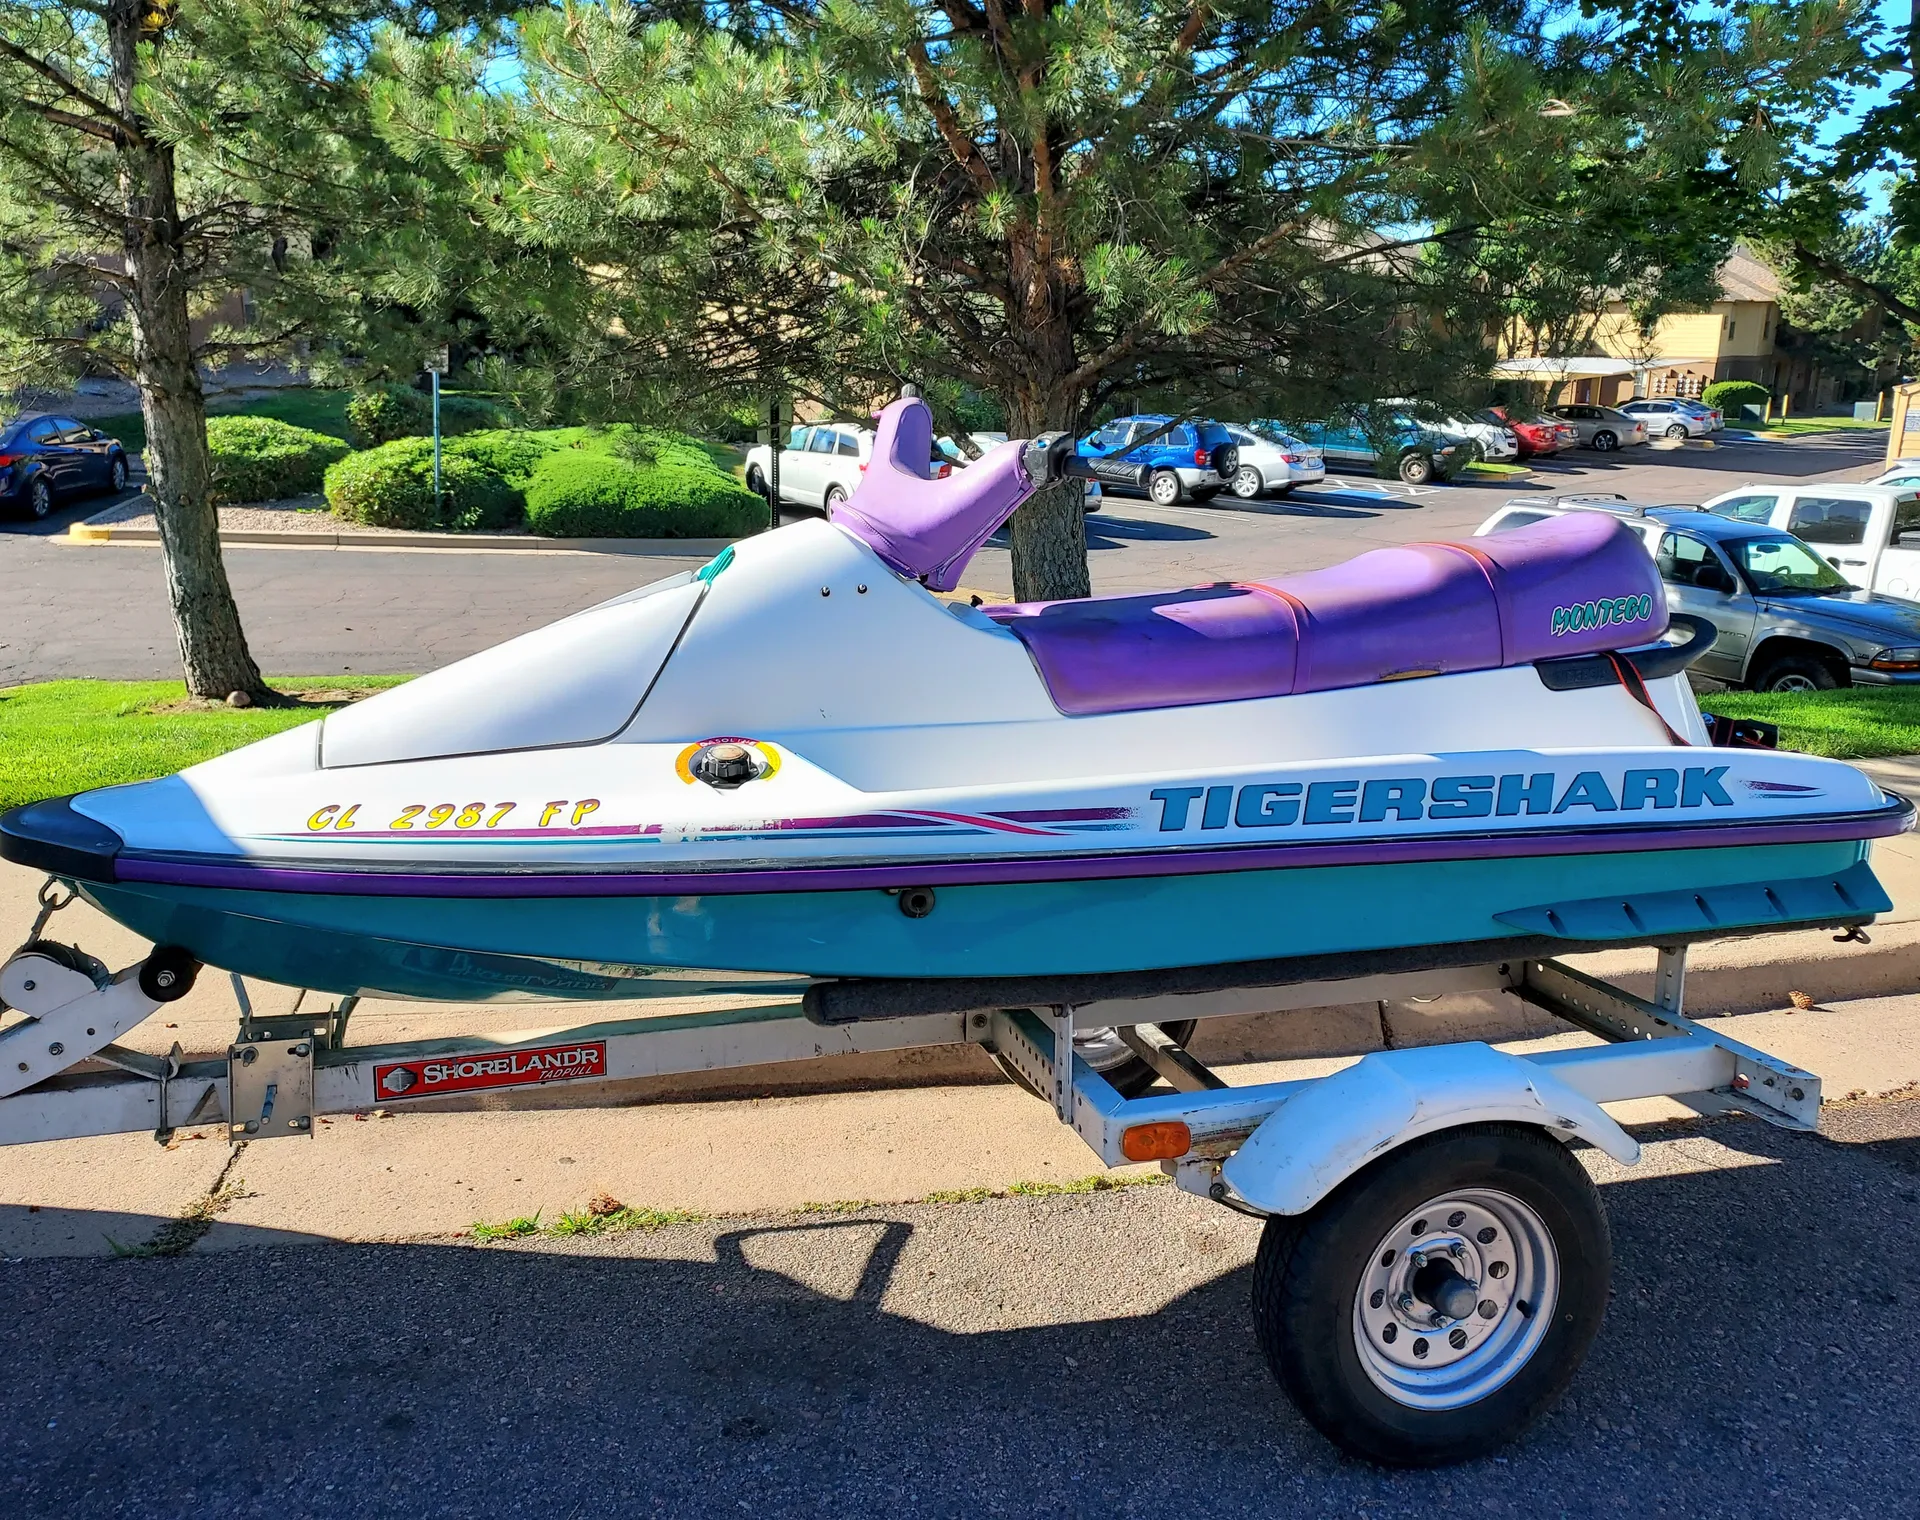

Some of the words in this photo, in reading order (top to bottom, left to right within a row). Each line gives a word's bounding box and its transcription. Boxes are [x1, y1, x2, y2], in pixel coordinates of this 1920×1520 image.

[1551, 593, 1653, 637] MONTEGO
[699, 738, 757, 747] GASOLINE
[1150, 766, 1734, 831] TIGERSHARK
[306, 804, 362, 831] CL
[389, 802, 517, 829] 2987
[538, 799, 600, 826] FP
[538, 1065, 593, 1081] TADPULL
